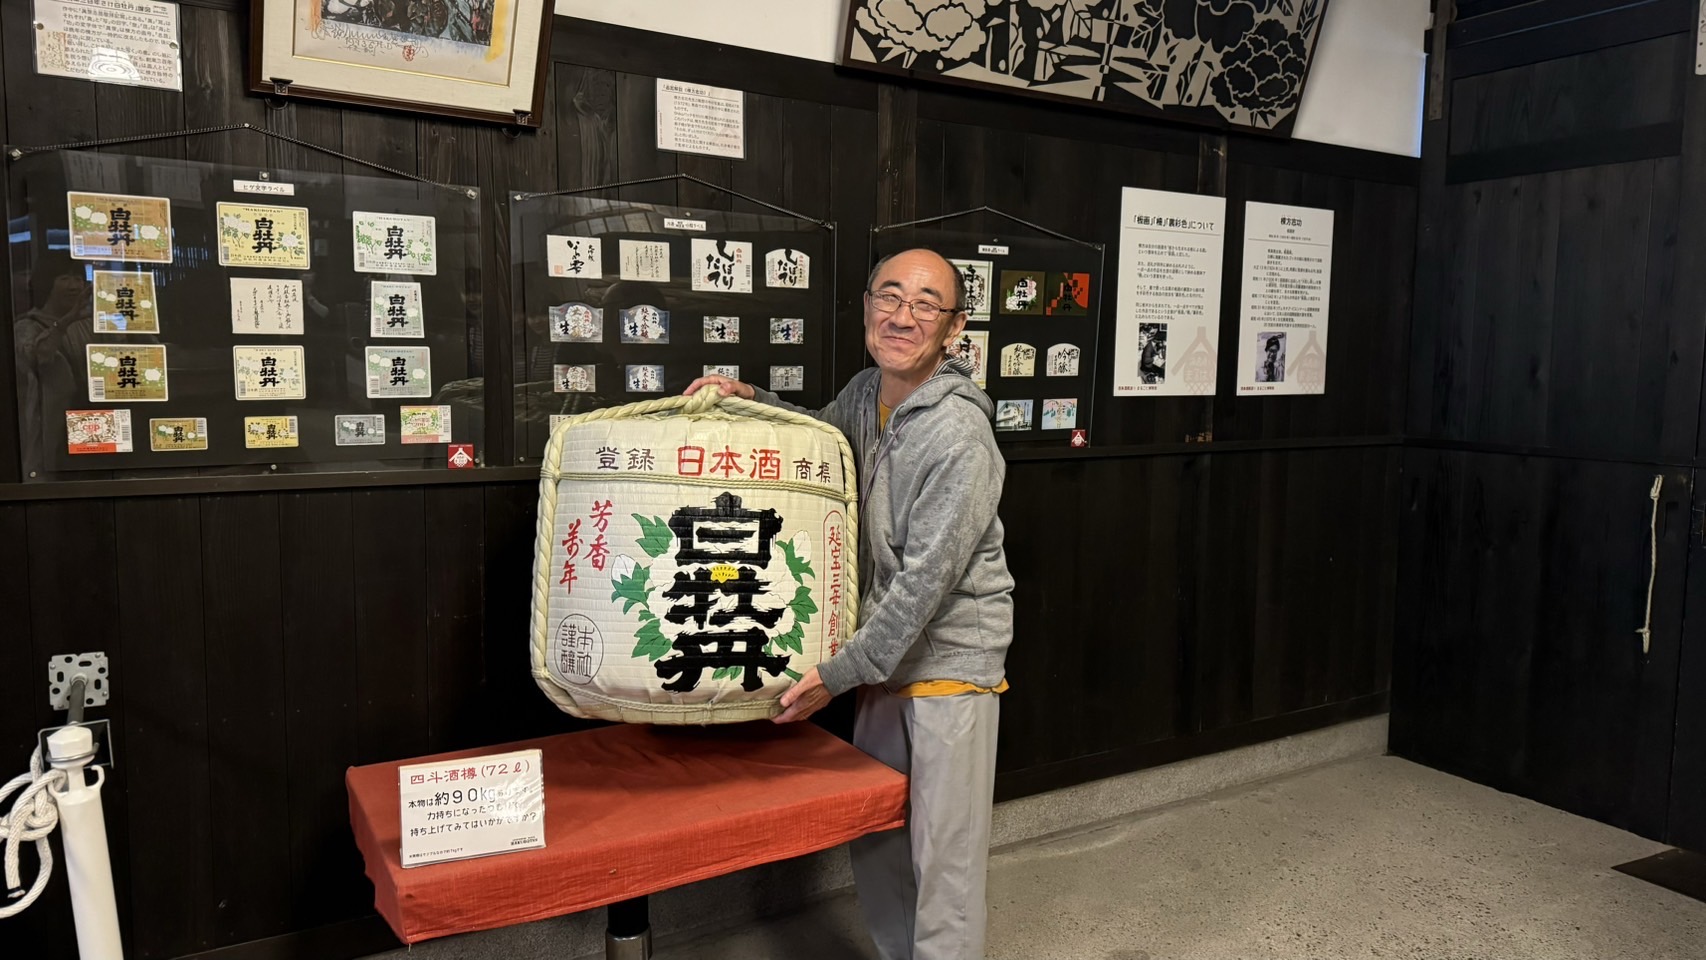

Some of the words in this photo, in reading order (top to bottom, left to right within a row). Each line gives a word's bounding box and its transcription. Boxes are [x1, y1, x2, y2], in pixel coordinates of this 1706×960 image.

[243, 184, 285, 193] ヒゲ文字ラベル
[107, 207, 135, 246] 白牡丹
[252, 217, 277, 254] 白牡丹
[384, 225, 407, 260] 白牡丹
[115, 287, 139, 320] 白牡丹
[387, 294, 409, 327] 白牡丹
[1016, 278, 1028, 311] 白牡丹
[560, 321, 570, 335] 生
[629, 322, 638, 336] 生
[716, 323, 726, 339] 生
[781, 324, 791, 340] 生
[117, 355, 141, 388] 白牡丹
[259, 356, 280, 387] 白牡丹
[390, 357, 409, 386] 白牡丹
[562, 379, 570, 390] 生
[633, 379, 640, 389] 生
[266, 424, 277, 440] 白牡丹
[596, 446, 655, 471] 登録
[677, 445, 780, 480] 日本酒
[793, 457, 831, 483] 商標
[583, 499, 613, 572] 芳香
[654, 491, 791, 693] 白牡丹
